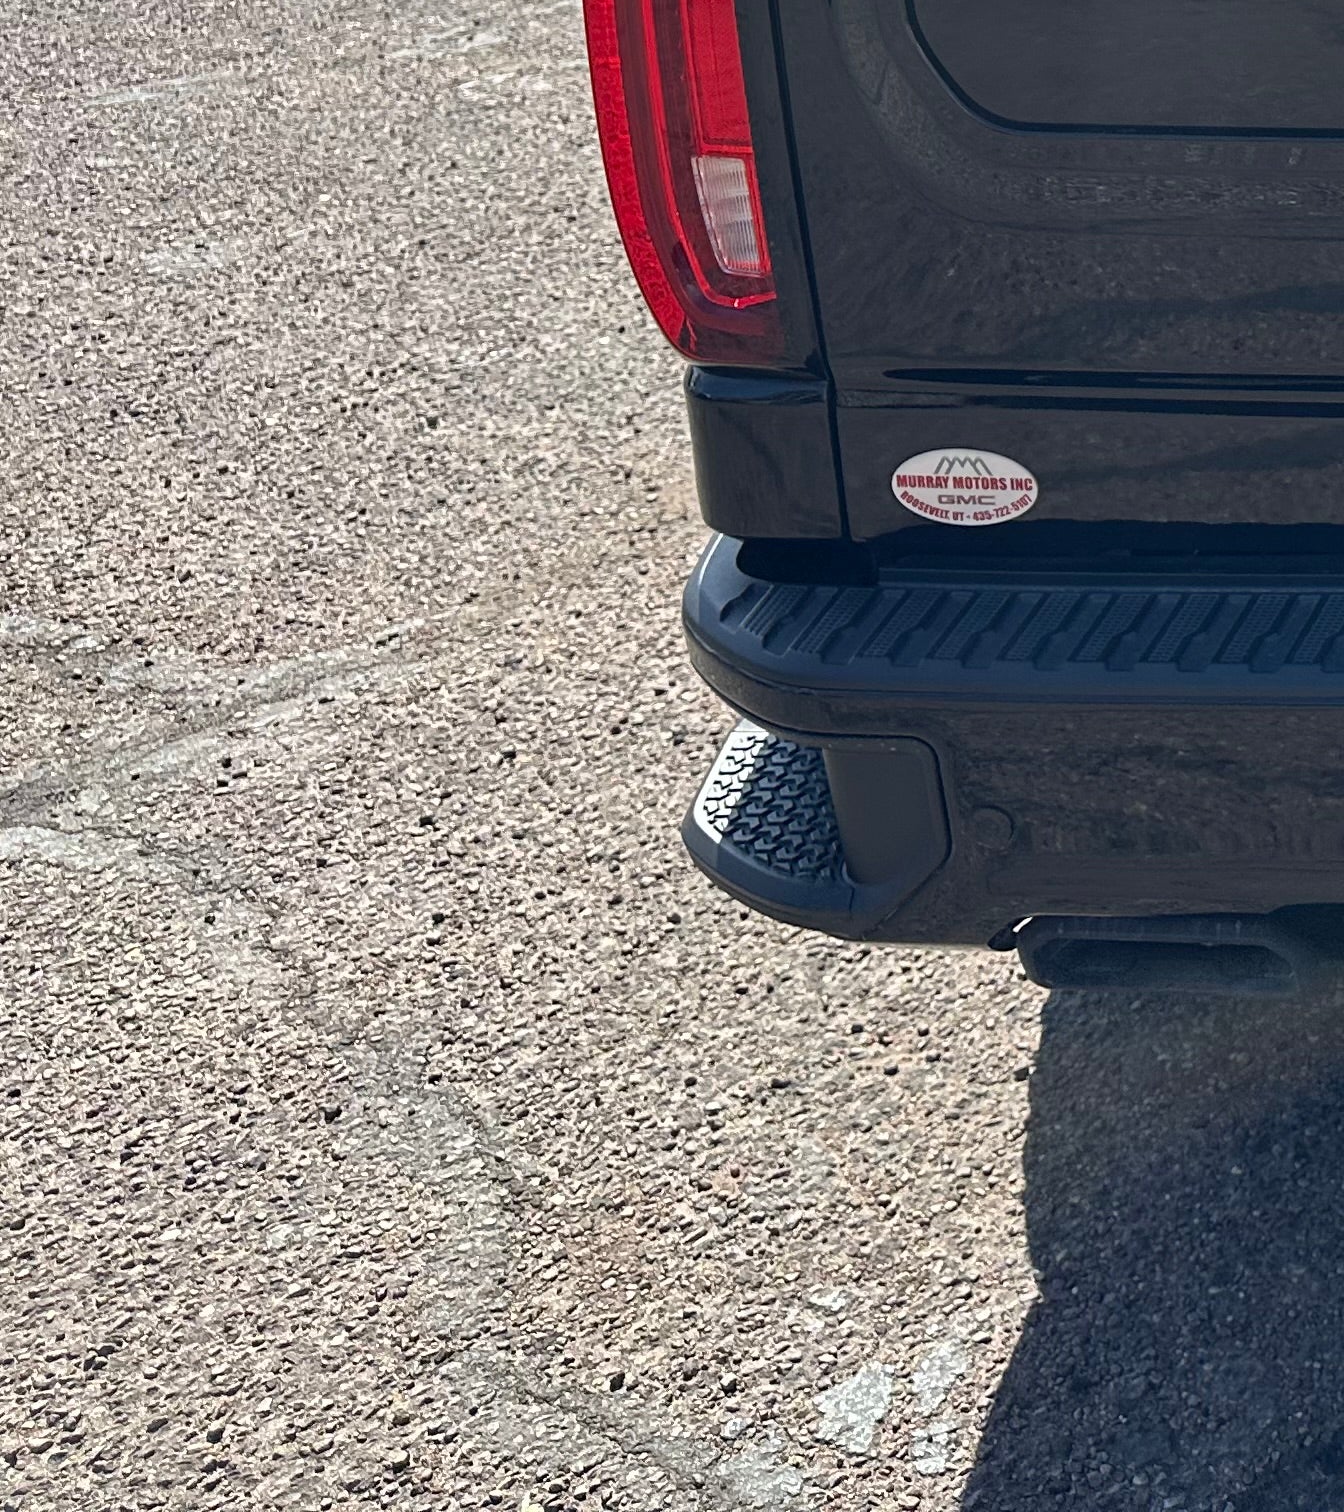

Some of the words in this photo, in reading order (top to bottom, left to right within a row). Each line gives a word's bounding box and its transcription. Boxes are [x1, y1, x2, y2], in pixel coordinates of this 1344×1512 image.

[896, 474, 949, 489] MURRAY
[952, 476, 1008, 491] MOTORS
[1010, 477, 1034, 492] INC
[938, 494, 996, 506] GMC
[952, 511, 965, 522] UT
[972, 493, 1033, 522] 435-722-5107
